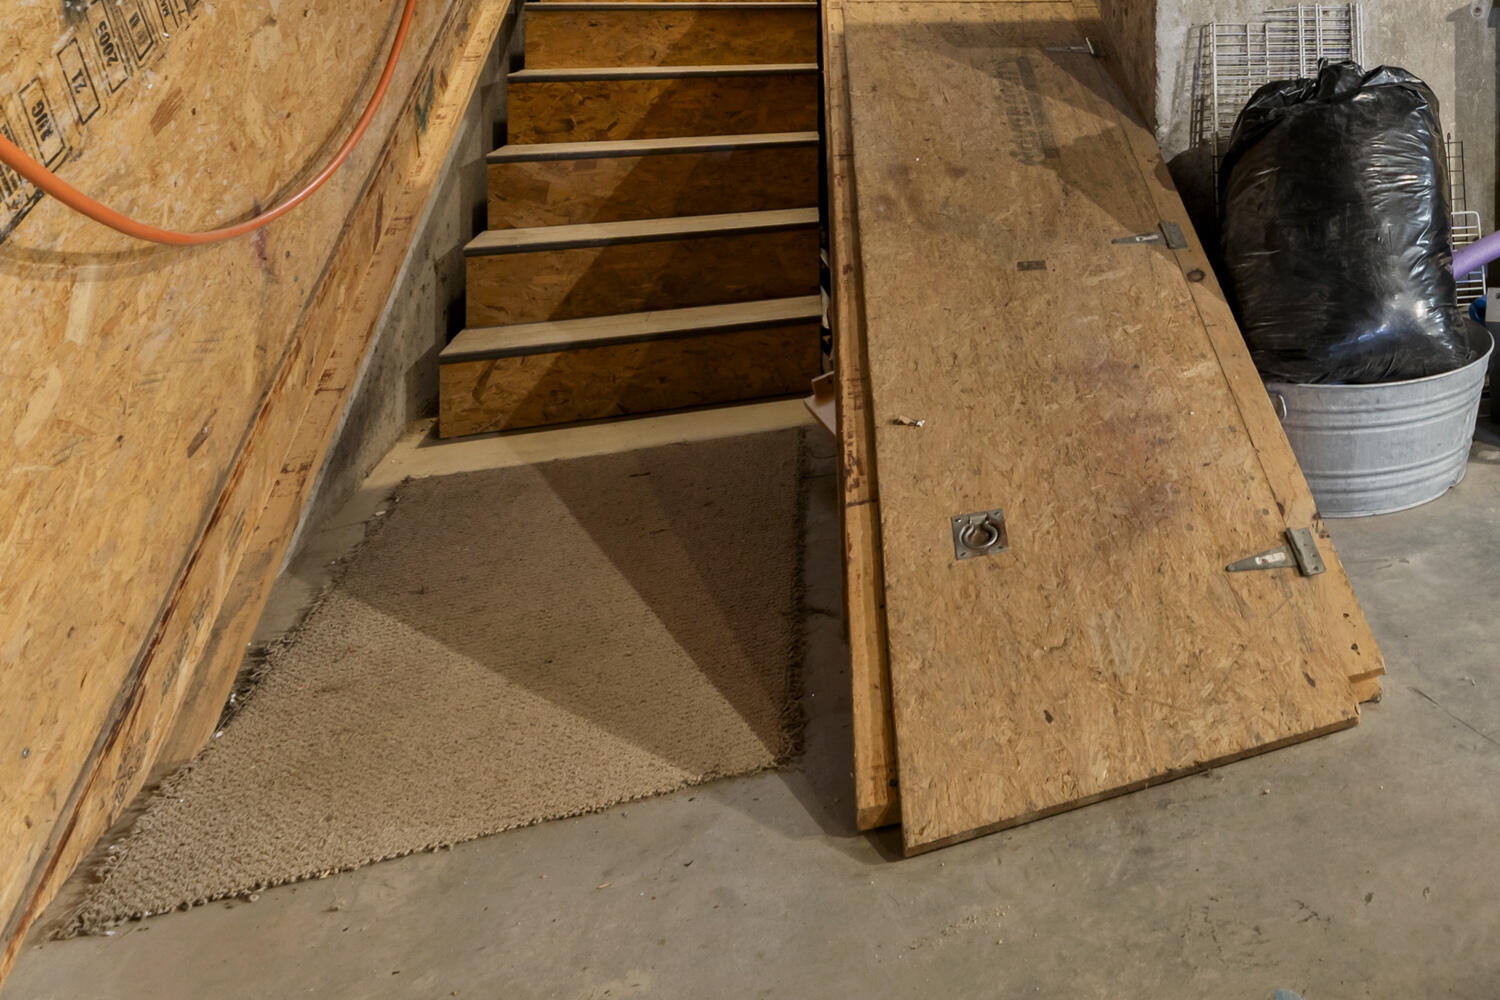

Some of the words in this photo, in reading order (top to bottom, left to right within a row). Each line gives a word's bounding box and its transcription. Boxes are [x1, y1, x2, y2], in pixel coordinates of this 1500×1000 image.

[95, 20, 119, 67] 2005
[70, 68, 88, 94] 21
[31, 100, 54, 142] AUG
